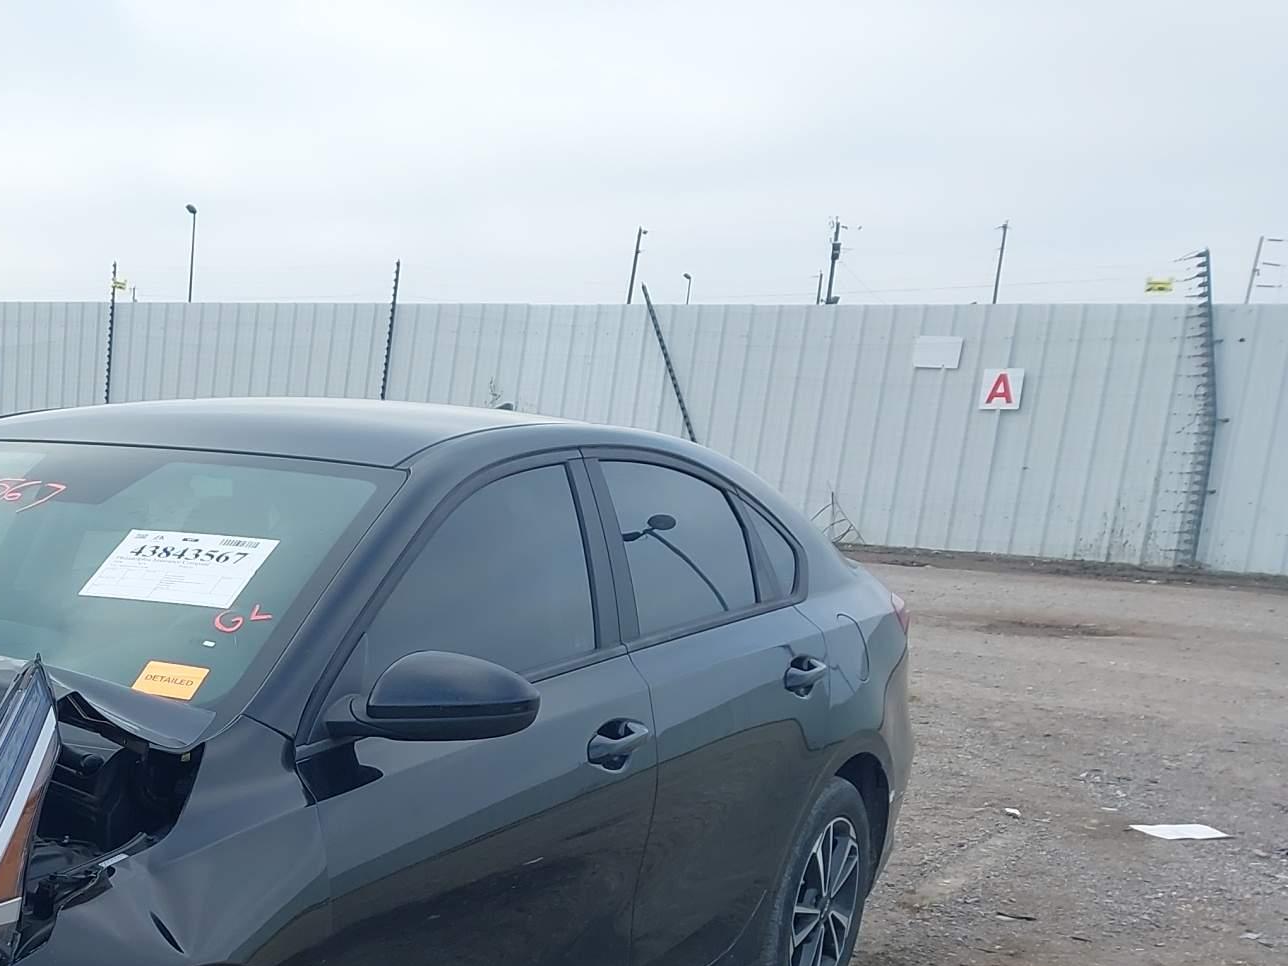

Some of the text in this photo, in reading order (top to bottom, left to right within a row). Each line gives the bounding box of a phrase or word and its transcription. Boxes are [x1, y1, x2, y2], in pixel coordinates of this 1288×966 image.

[985, 373, 1014, 405] A
[130, 544, 249, 565] 43843567
[144, 673, 194, 687] DETAILED
